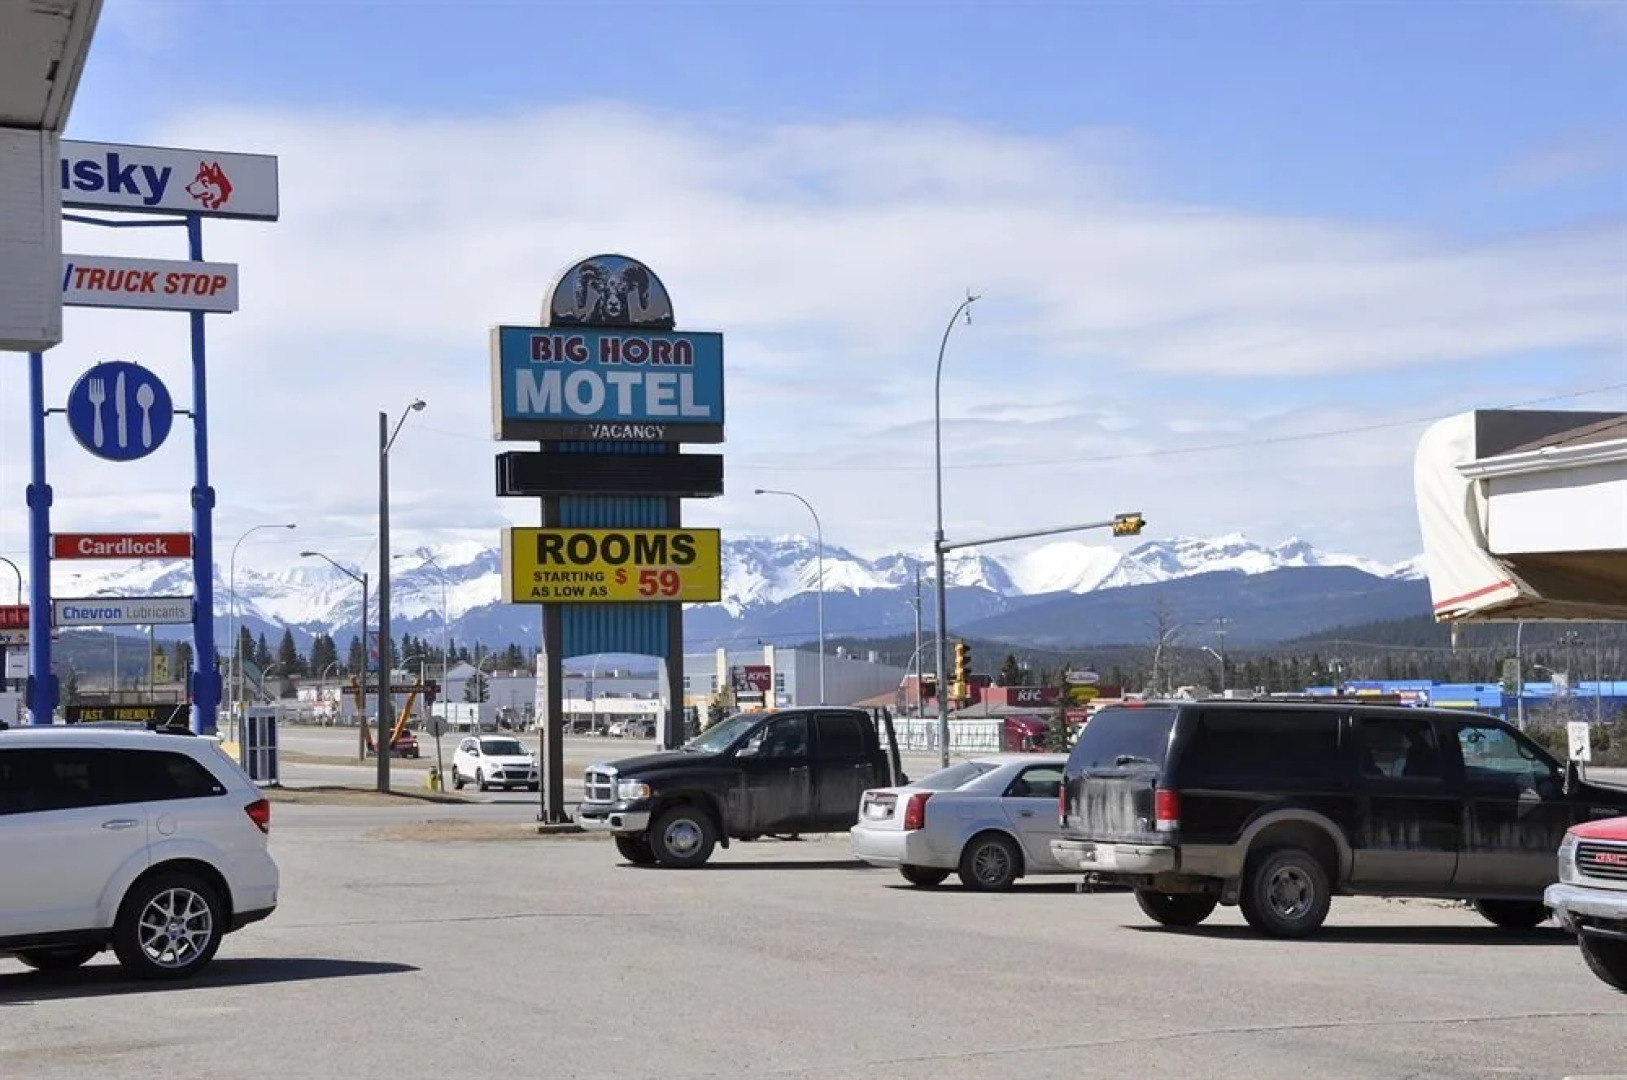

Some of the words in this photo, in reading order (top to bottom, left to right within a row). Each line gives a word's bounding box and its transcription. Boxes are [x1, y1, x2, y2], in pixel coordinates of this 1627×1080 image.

[164, 273, 227, 297] STOP
[530, 335, 588, 362] BIG
[600, 337, 693, 366] HORN
[515, 368, 711, 417] MOTEL
[589, 423, 665, 439] VACANCY
[77, 537, 168, 555] Cardlock
[536, 533, 697, 566] ROOMS
[533, 571, 605, 583] STARTING
[531, 586, 550, 598] AS
[554, 586, 584, 598] LOW
[590, 586, 608, 598] AS
[62, 605, 122, 620] Chevron
[126, 605, 186, 620] Lubricants
[747, 671, 770, 681] KFC
[1017, 689, 1042, 702] KFC
